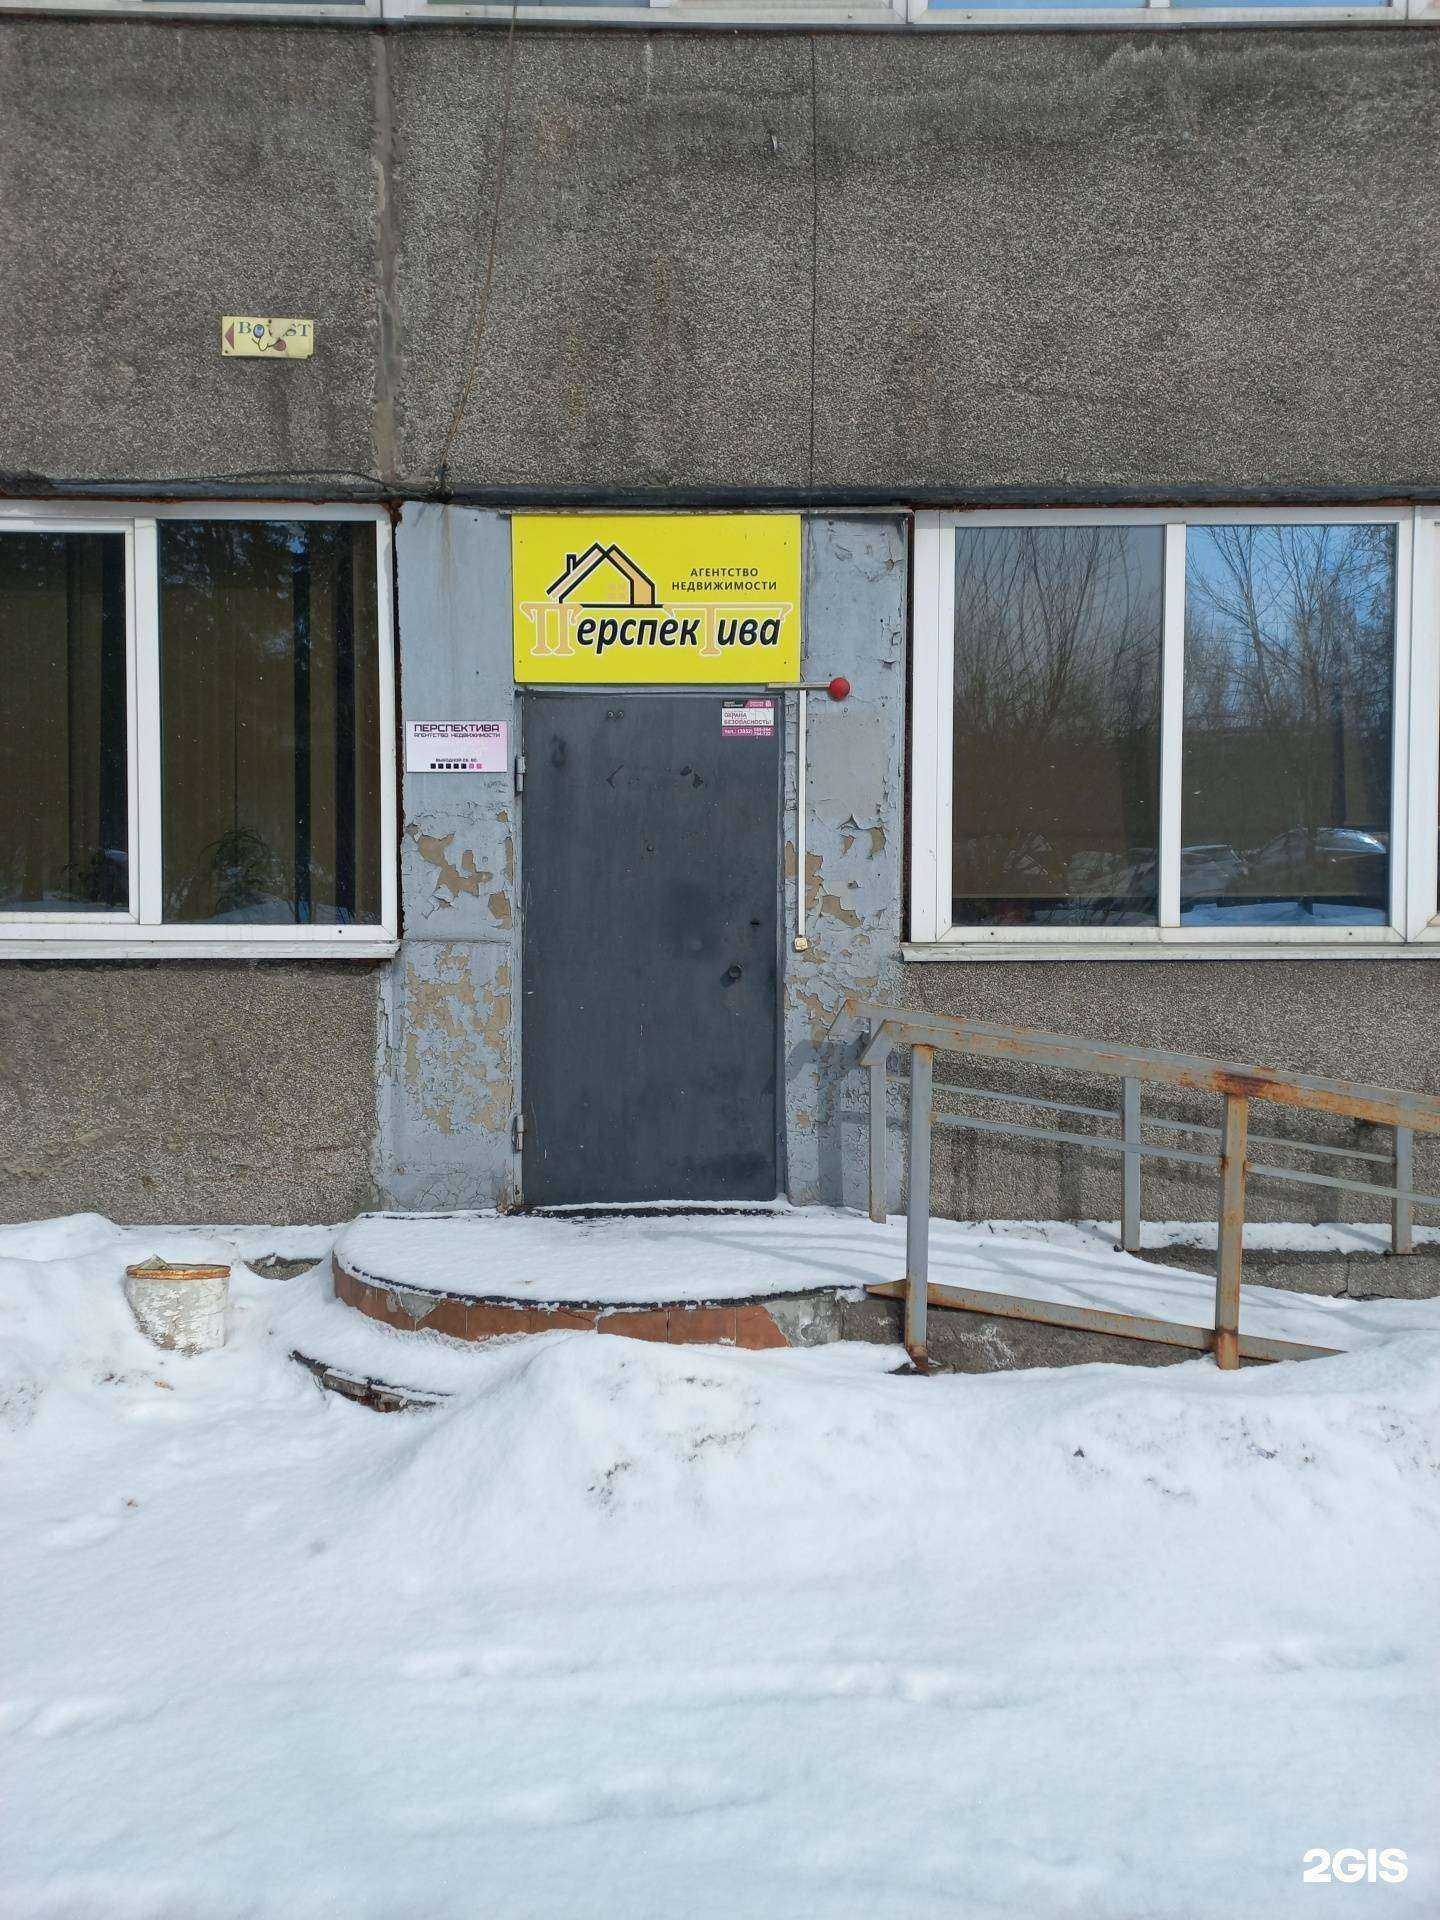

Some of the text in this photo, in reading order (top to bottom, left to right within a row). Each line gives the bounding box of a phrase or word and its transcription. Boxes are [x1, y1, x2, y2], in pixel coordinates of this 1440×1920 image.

[239, 320, 312, 338] BOST
[690, 567, 759, 577] АГЕНТСТВО
[671, 580, 778, 592] НЕДВИЖИМОСТИ
[414, 724, 500, 732] ПЕРСПЕКТИВА
